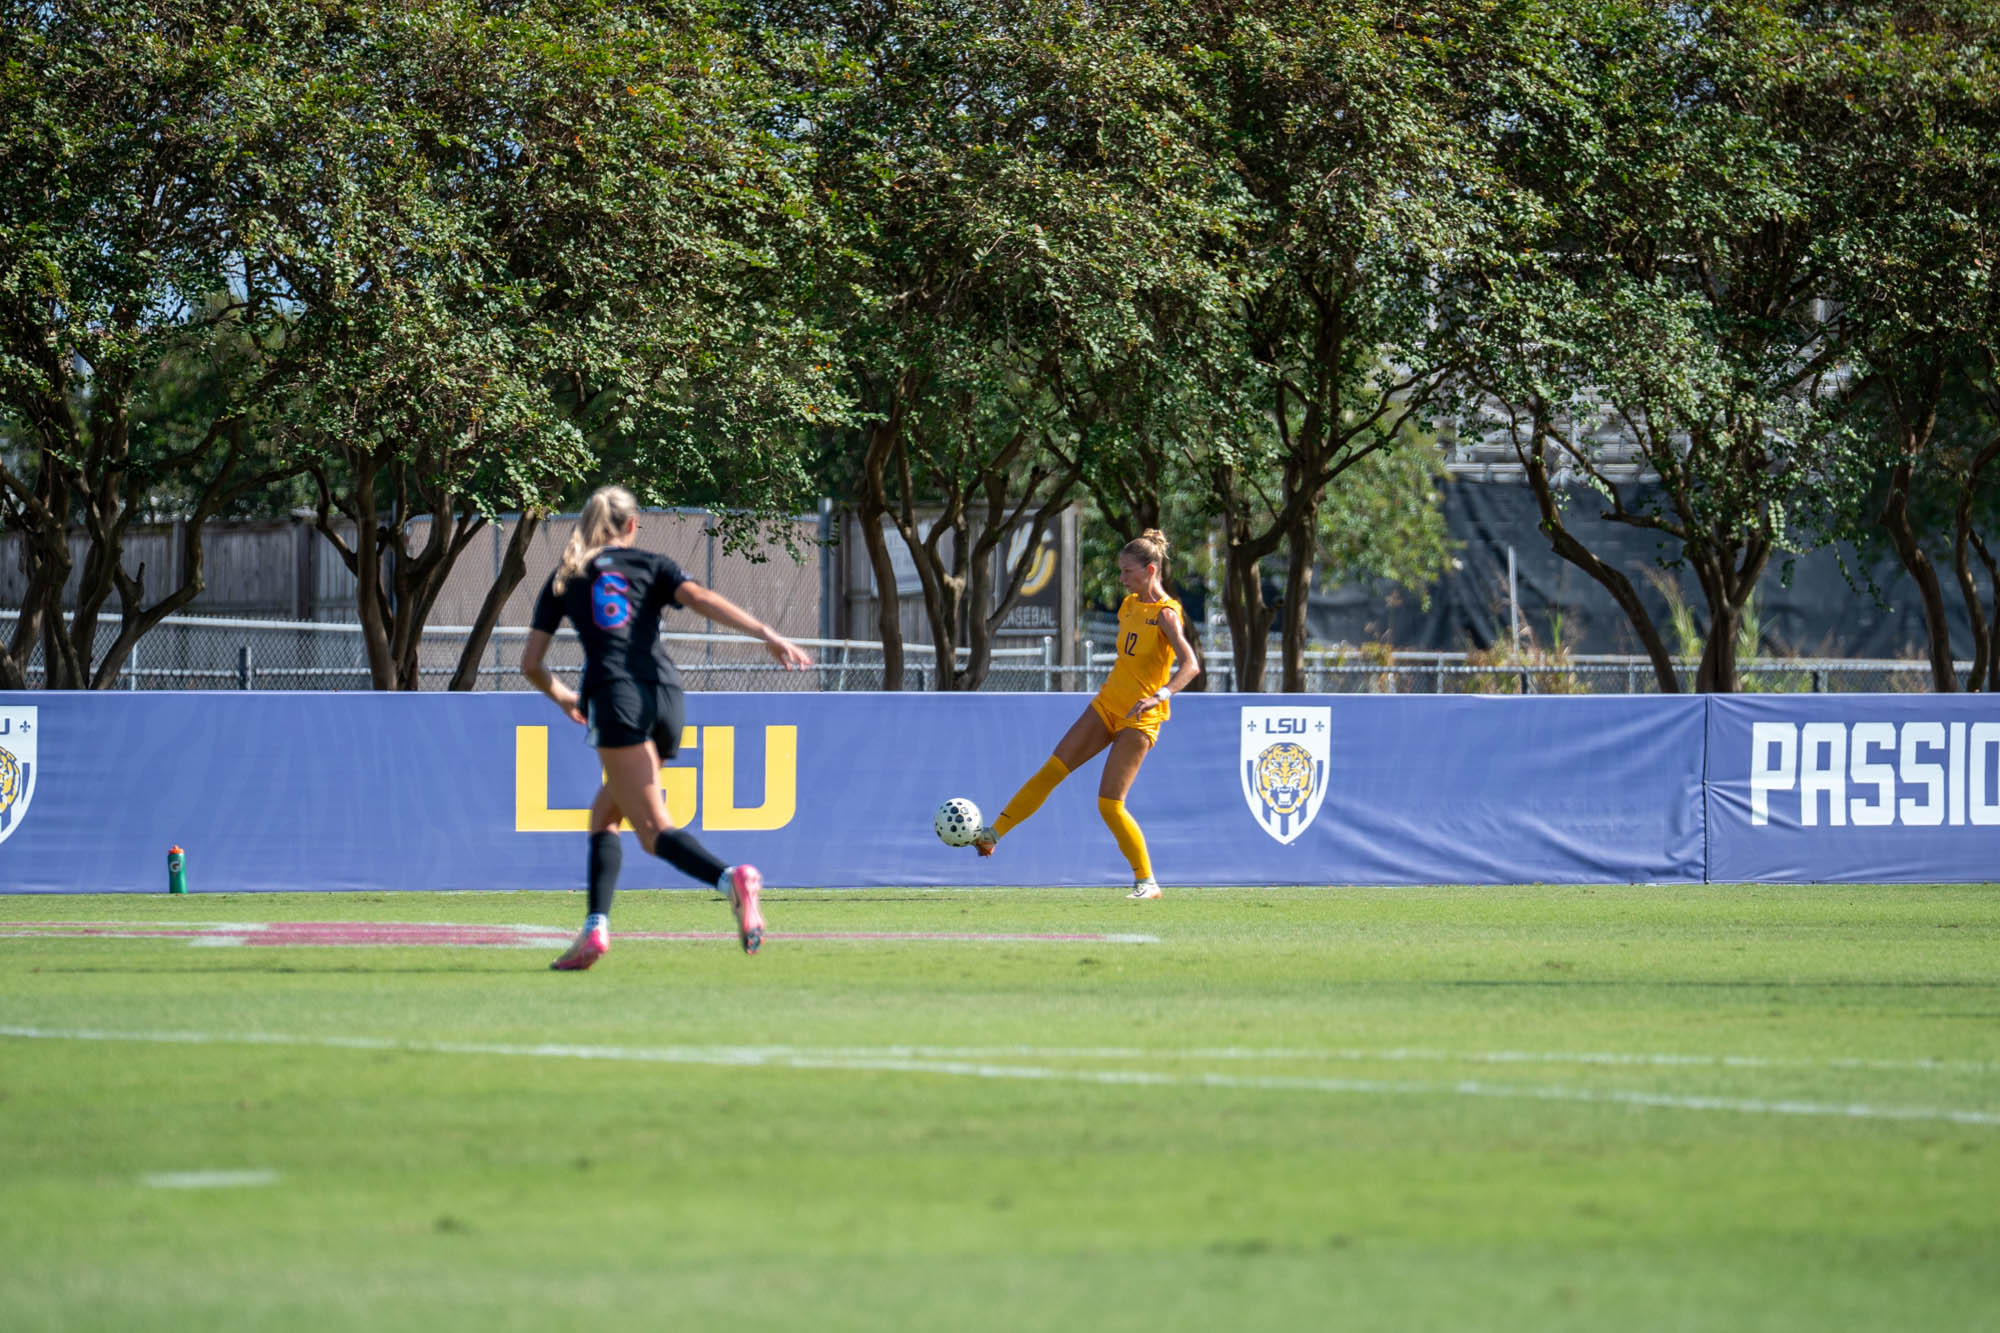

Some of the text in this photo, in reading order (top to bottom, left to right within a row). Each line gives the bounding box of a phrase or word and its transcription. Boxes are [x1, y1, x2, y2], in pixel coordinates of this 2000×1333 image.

[592, 571, 633, 629] 6
[1000, 606, 1057, 626] ASEBAL
[1124, 631, 1139, 656] 12
[1265, 718, 1307, 734] LSU
[1751, 722, 2000, 826] PASSIO
